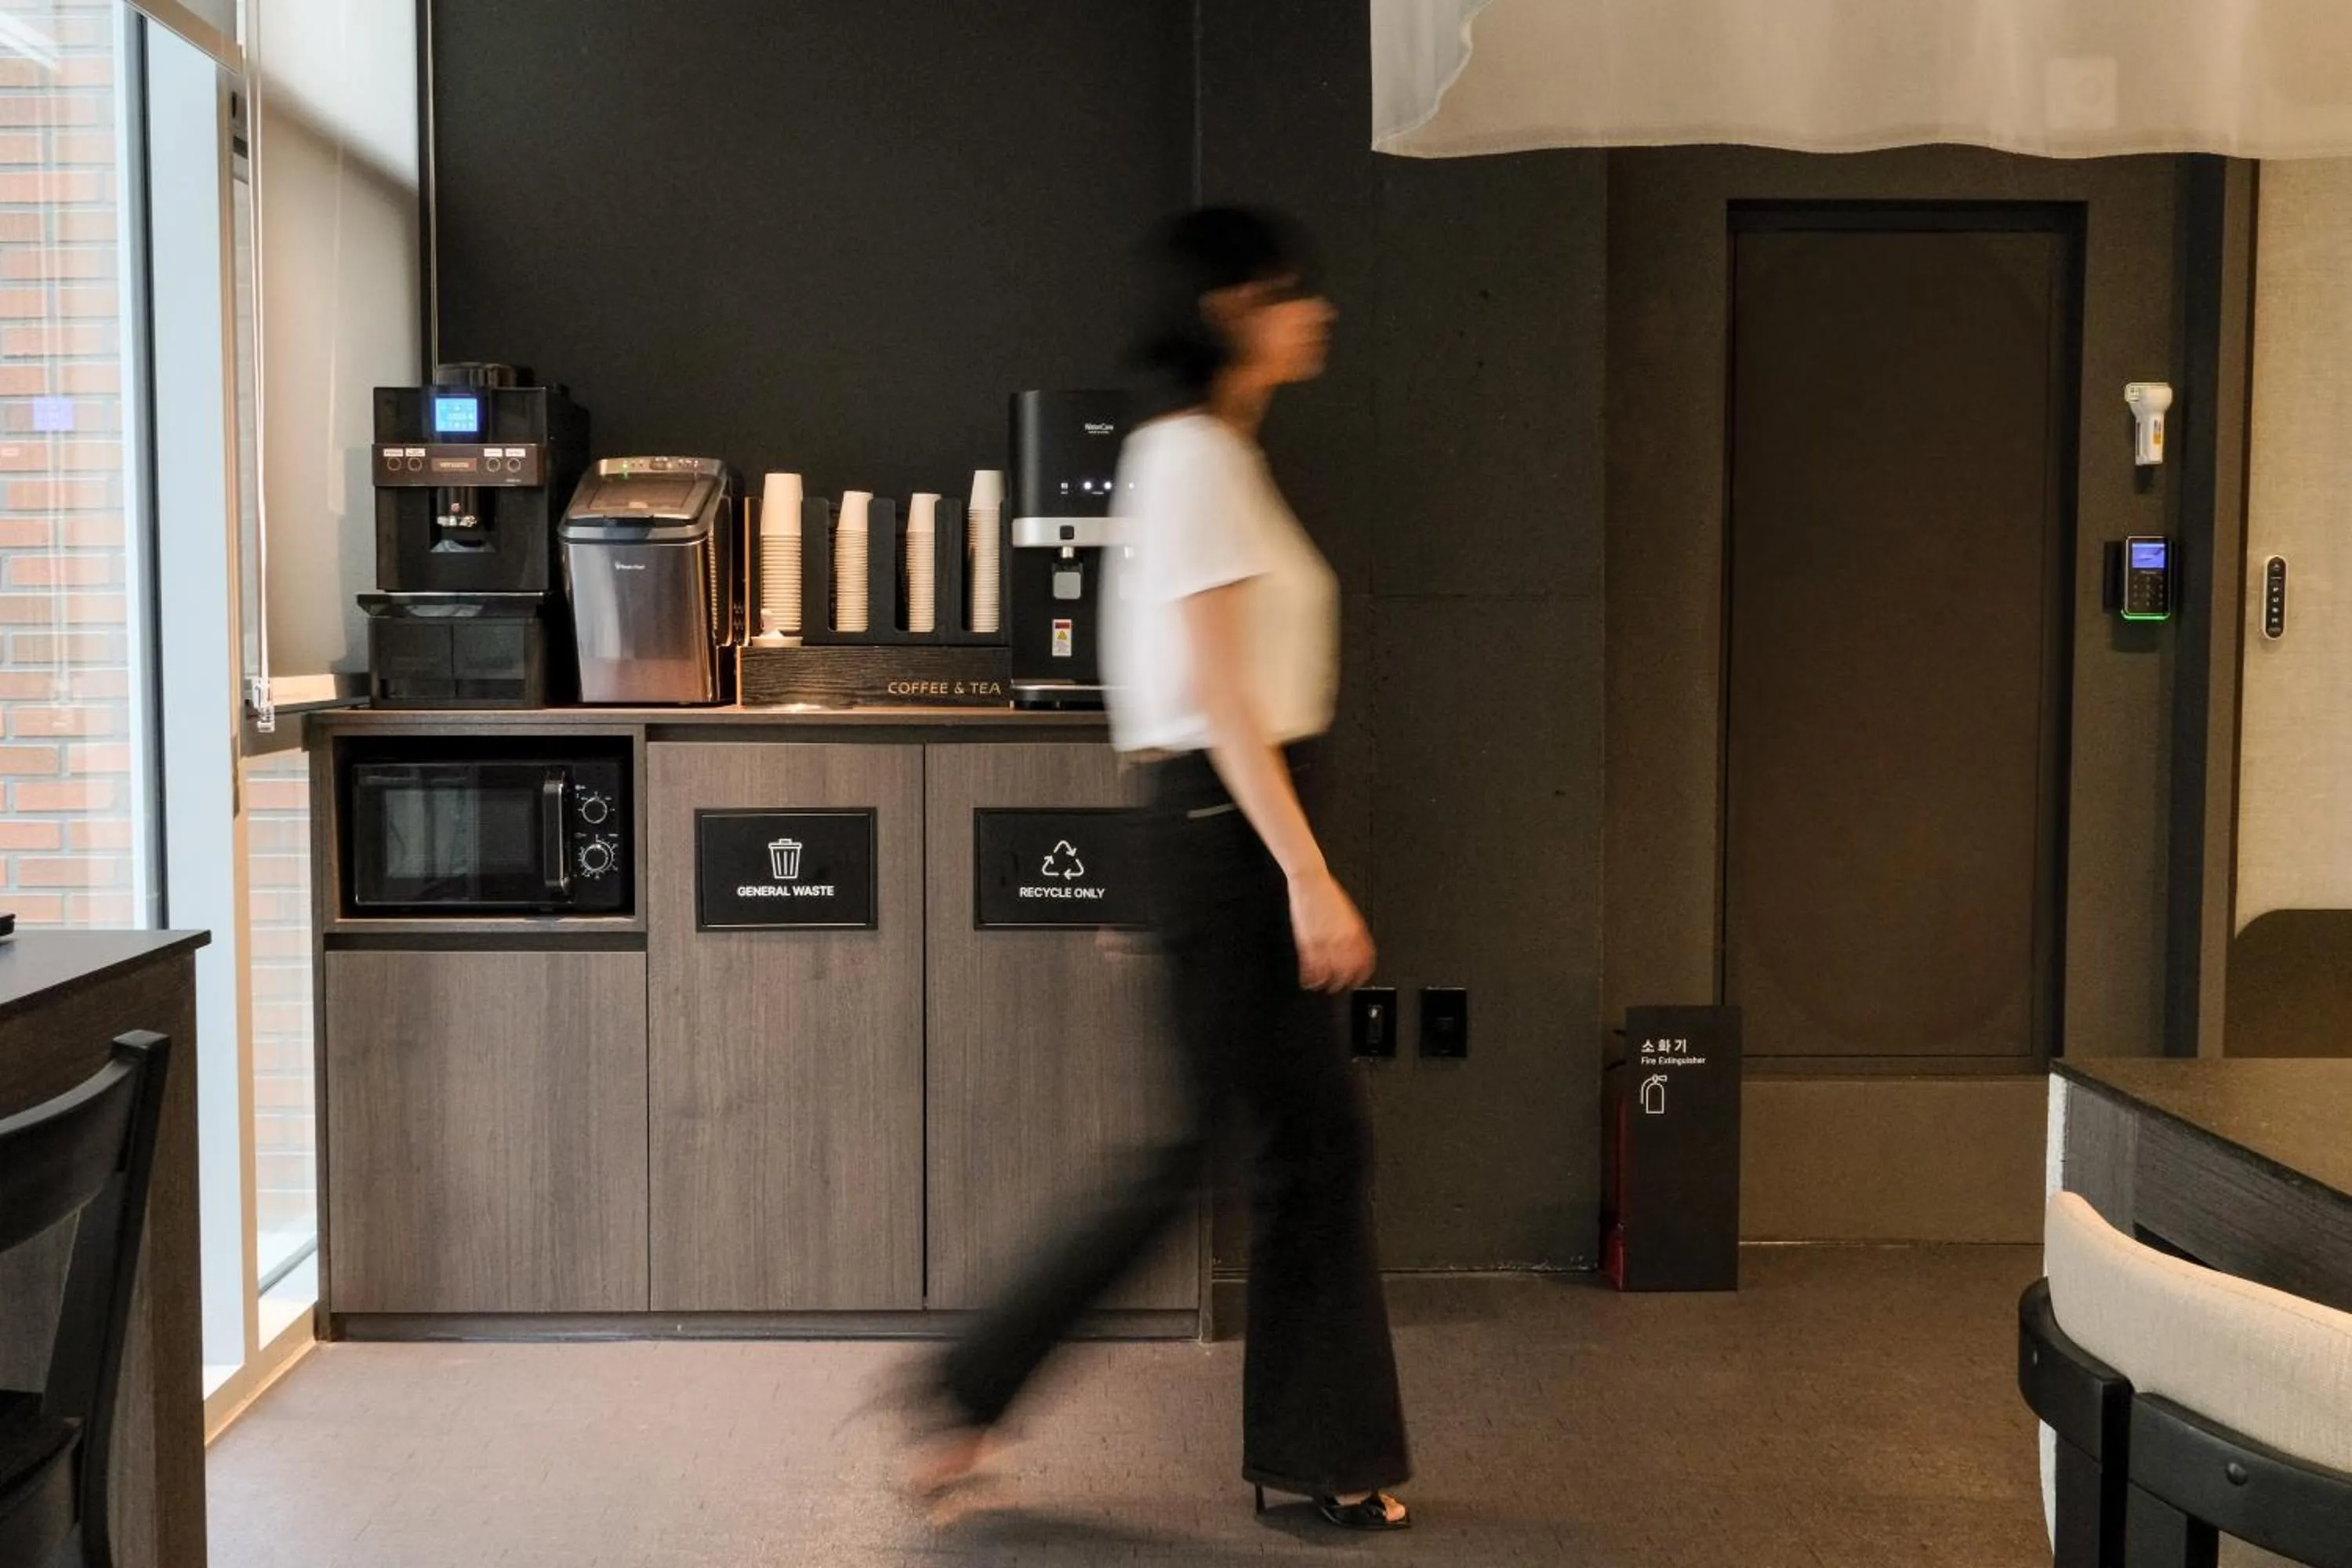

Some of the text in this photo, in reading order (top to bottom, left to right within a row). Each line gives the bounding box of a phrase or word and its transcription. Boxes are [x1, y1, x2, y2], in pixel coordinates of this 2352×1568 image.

[887, 681, 1001, 695] COFFEE & TEA
[736, 885, 835, 897] GENERAL WASTE
[1019, 886, 1105, 898] RECYCLE ONLY
[1641, 1056, 1706, 1066] Fire Extinguisher
